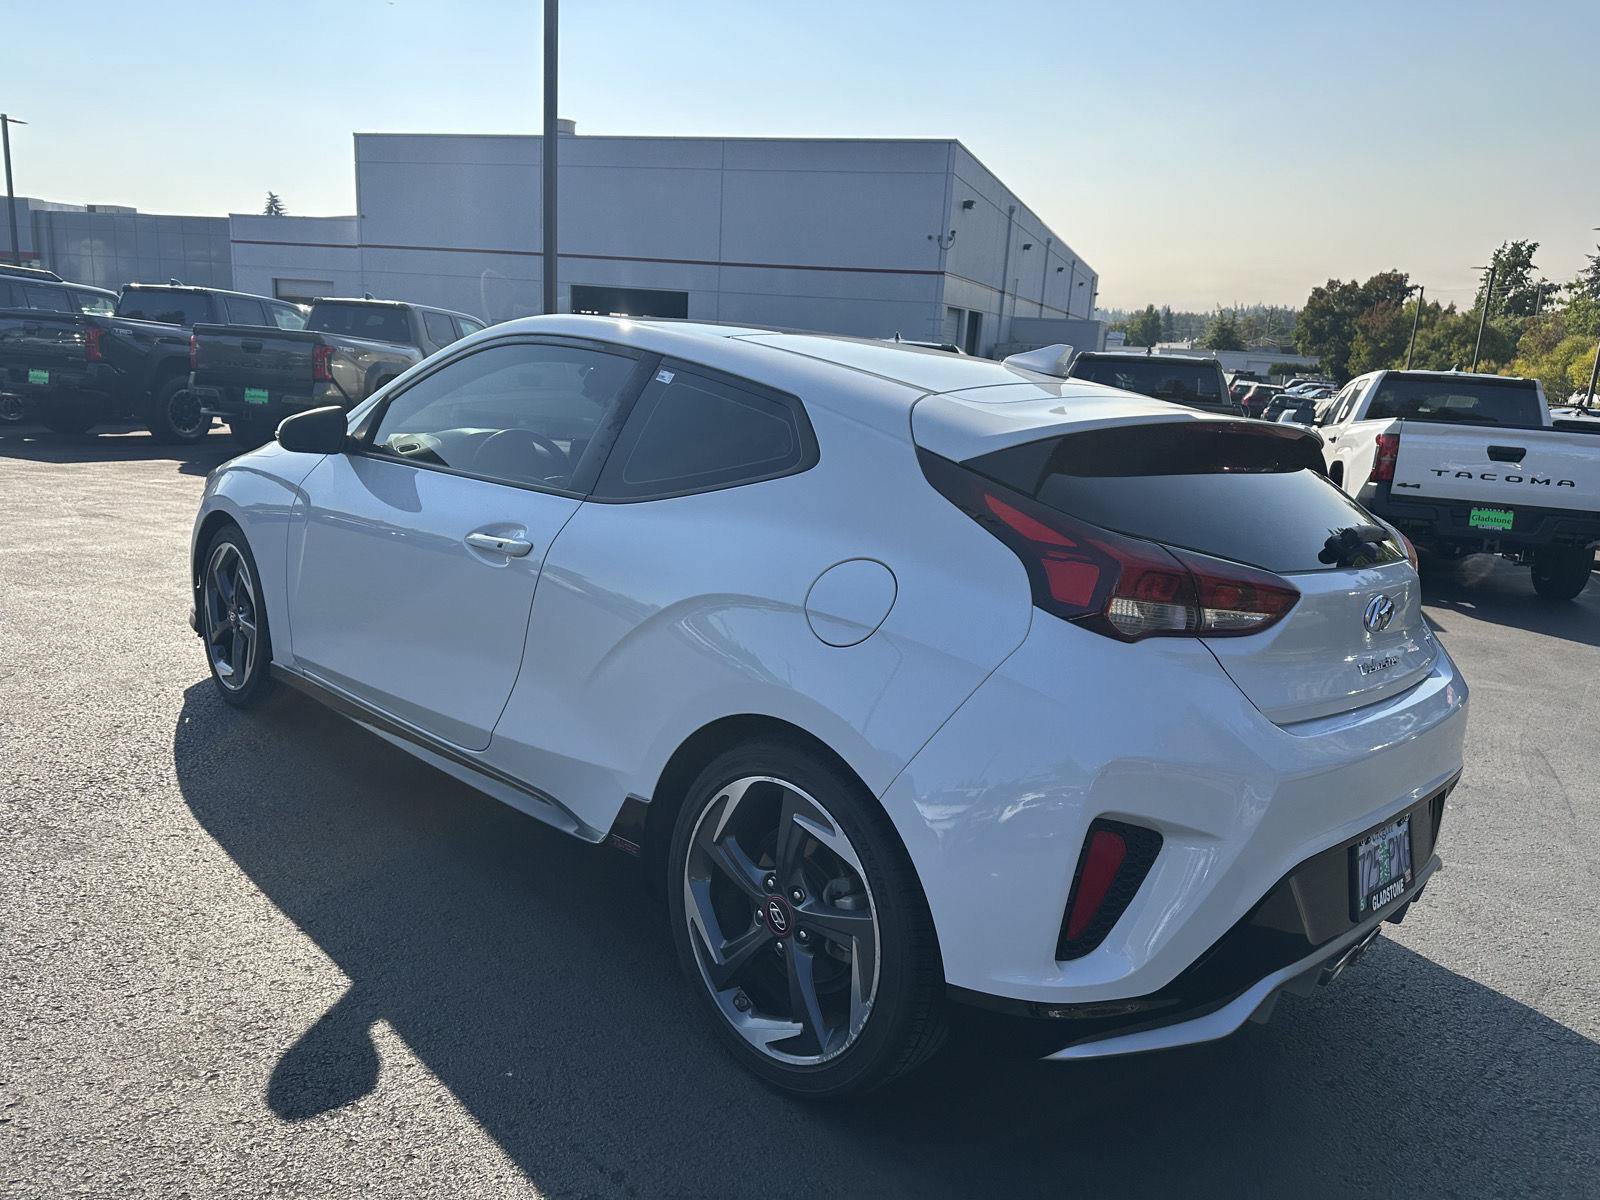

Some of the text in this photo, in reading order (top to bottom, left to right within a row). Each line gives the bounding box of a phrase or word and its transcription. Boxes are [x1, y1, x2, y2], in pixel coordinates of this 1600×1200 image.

[1431, 469, 1575, 487] TACOMA
[1471, 514, 1512, 525] Gladstone
[1371, 878, 1405, 911] GLADSTONE
